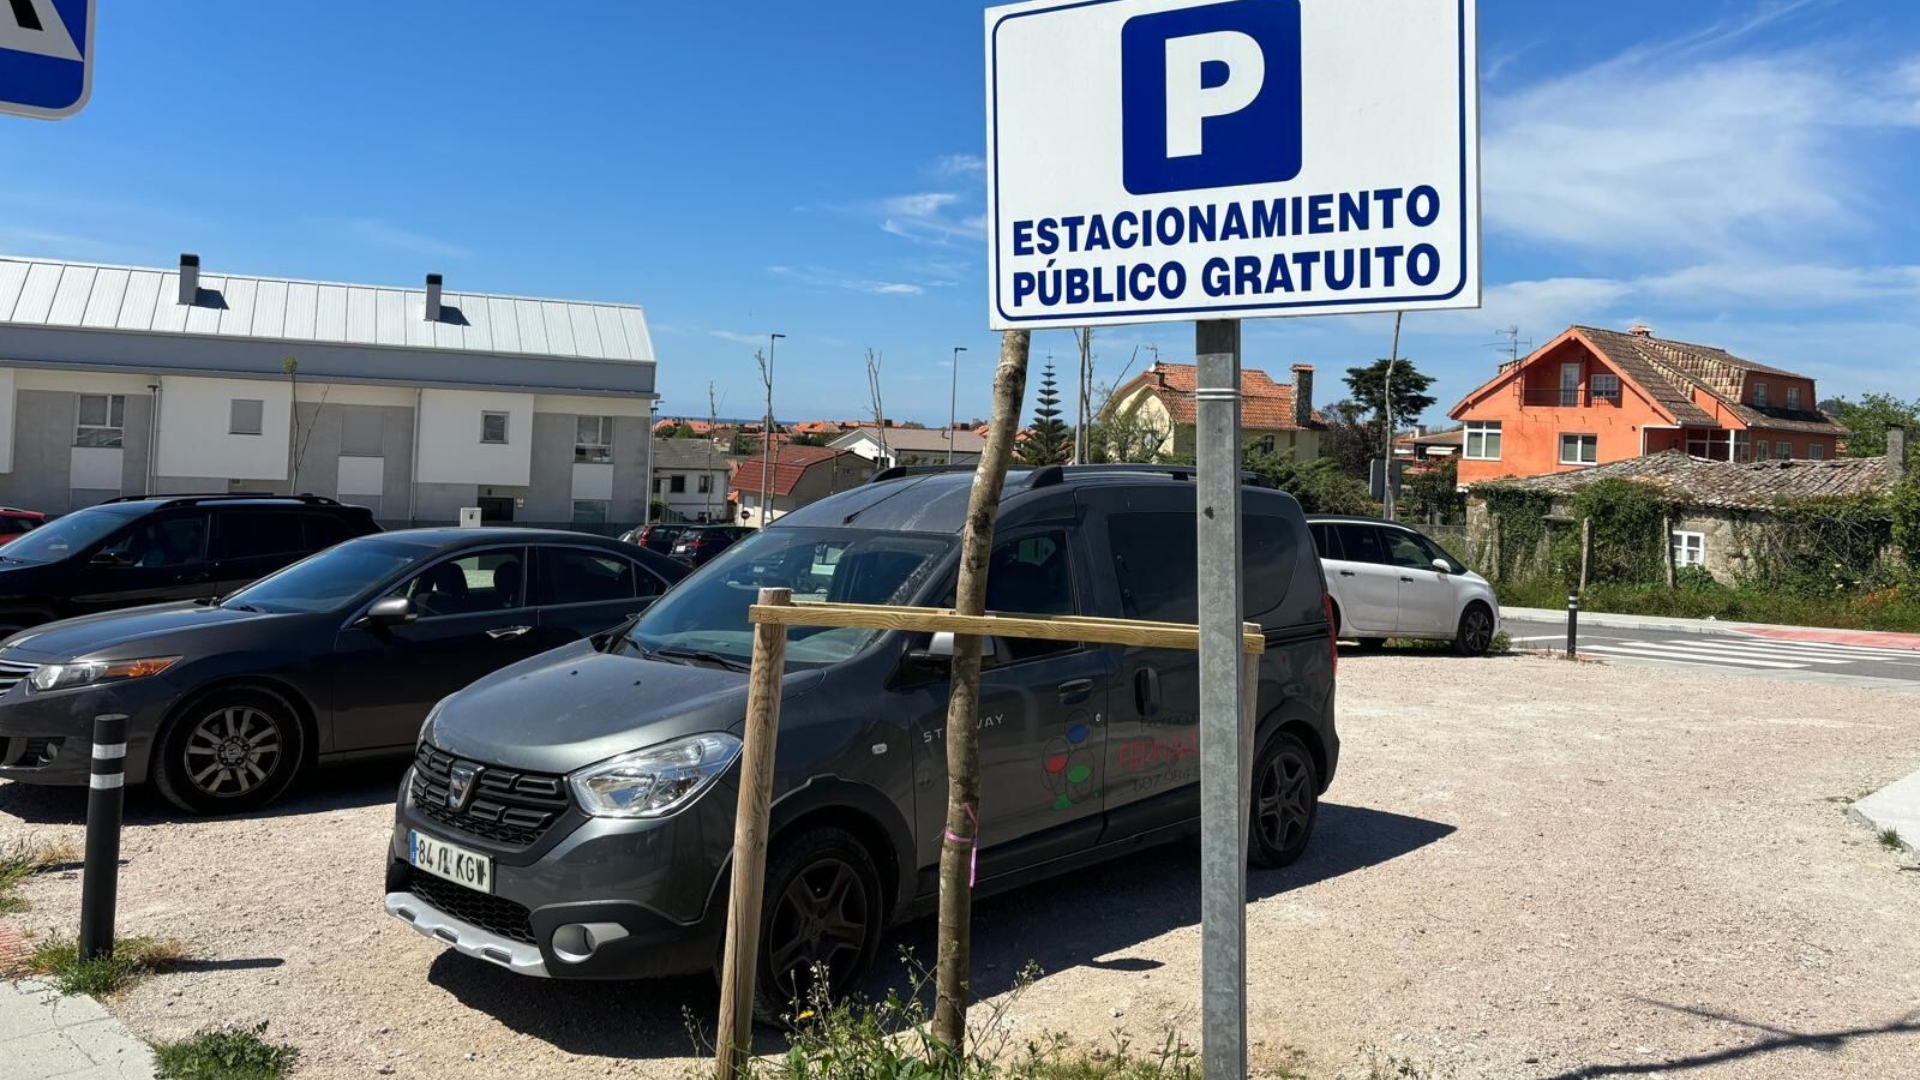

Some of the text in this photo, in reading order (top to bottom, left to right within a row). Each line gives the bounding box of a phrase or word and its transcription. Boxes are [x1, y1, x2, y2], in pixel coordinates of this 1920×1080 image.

[1166, 30, 1265, 159] P
[1013, 184, 1441, 257] ESTACIONAMIENTO
[1013, 242, 1441, 307] PÚBLICO GRATUITO
